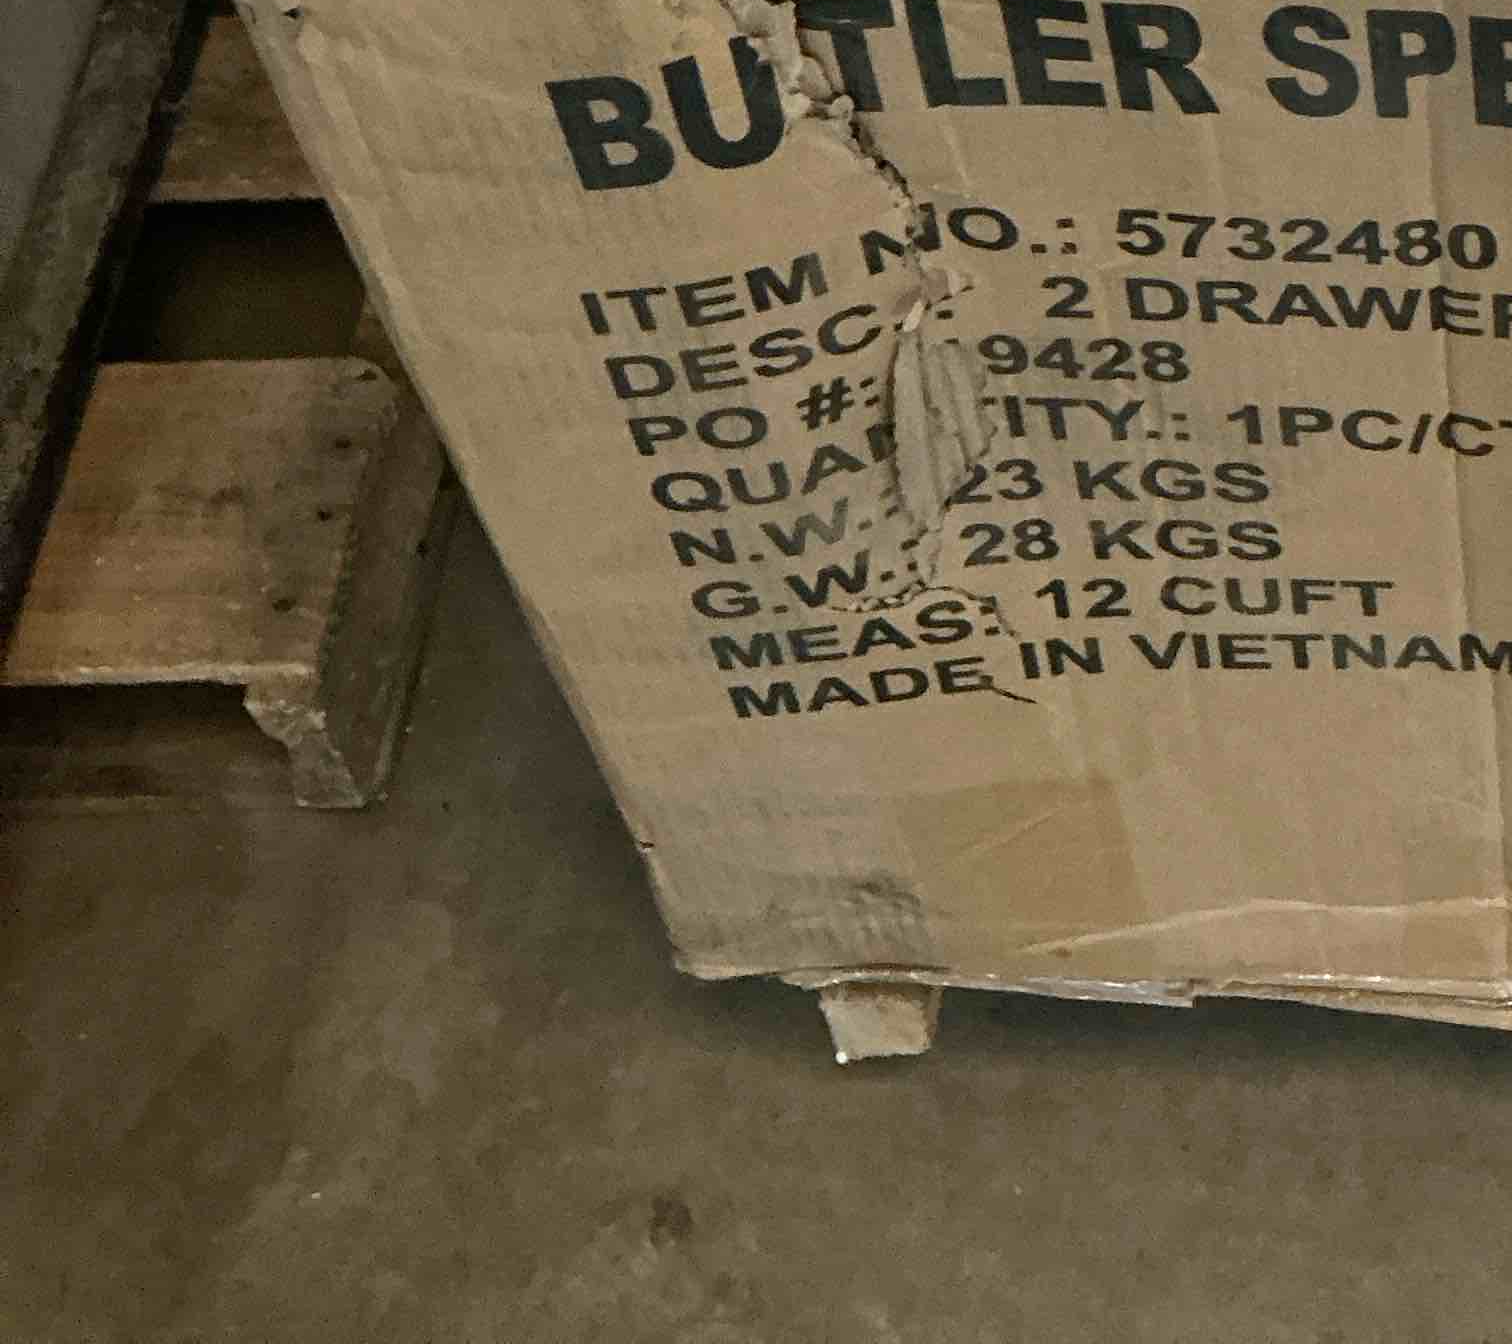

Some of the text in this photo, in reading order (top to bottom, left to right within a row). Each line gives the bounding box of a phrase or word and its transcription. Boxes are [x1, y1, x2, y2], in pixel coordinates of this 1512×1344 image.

[579, 252, 829, 336] ITEM
[1115, 208, 1498, 269] 5732480
[1041, 275, 1094, 319] 2
[628, 406, 769, 457] PO
[949, 458, 1045, 505] 23
[1072, 458, 1270, 503] KGS
[959, 517, 1061, 567] 28
[1088, 517, 1283, 562] KGS
[1035, 578, 1132, 620] 12
[1160, 575, 1394, 618] CUFT
[727, 656, 995, 719] MADE
[1019, 637, 1105, 680] IN
